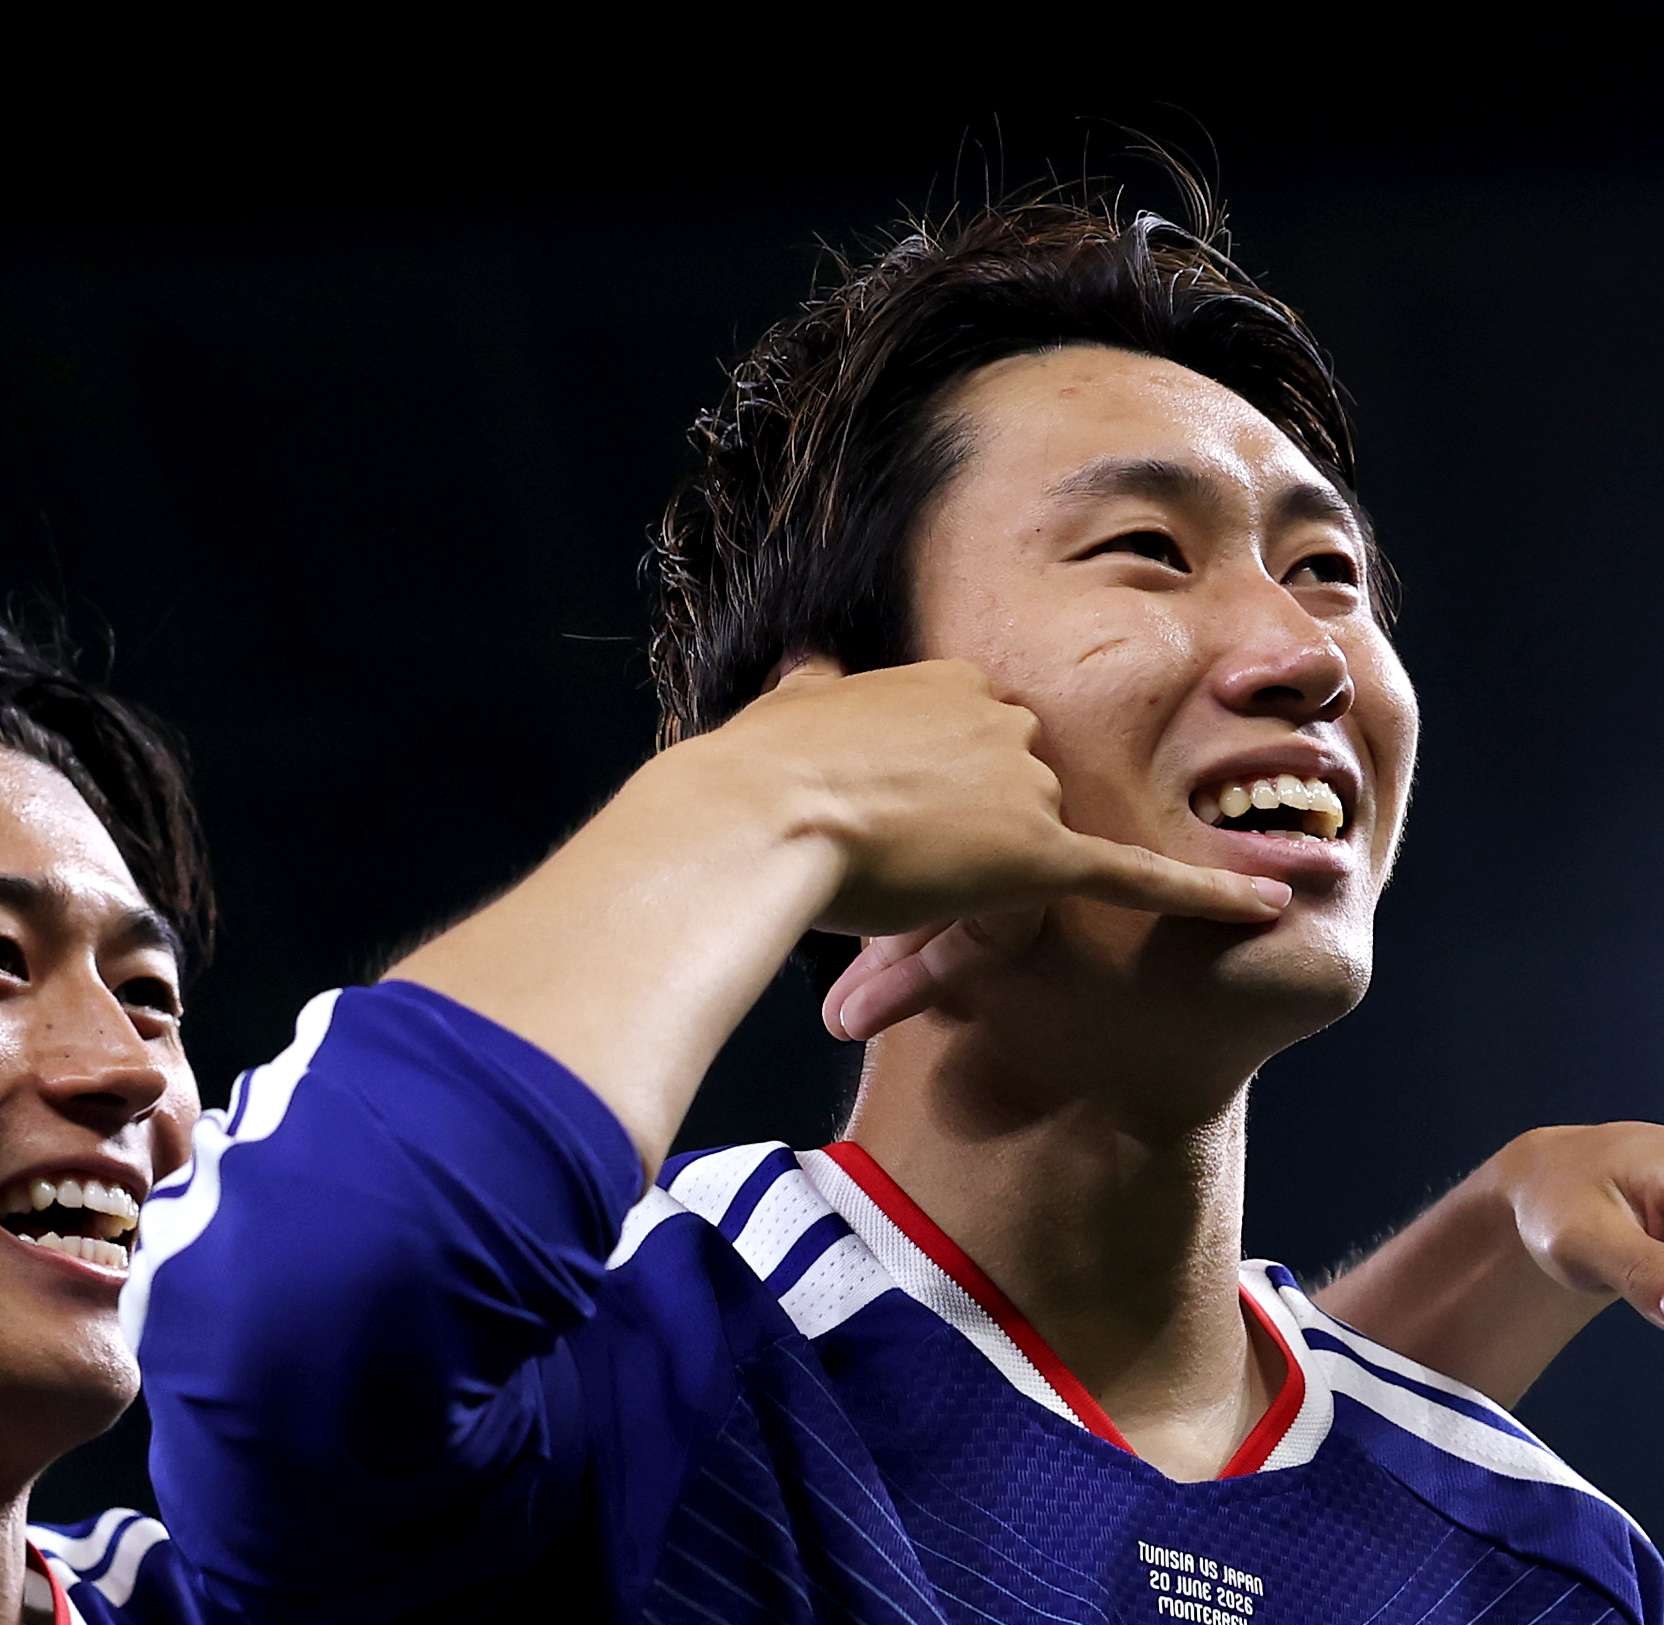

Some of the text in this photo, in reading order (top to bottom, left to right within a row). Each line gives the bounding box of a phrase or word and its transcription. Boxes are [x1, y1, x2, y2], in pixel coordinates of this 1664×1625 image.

[1138, 1541, 1195, 1574] TUNISIA
[1222, 1565, 1264, 1597] JAPAN
[1149, 1570, 1254, 1616] 20 JUNE 2026
